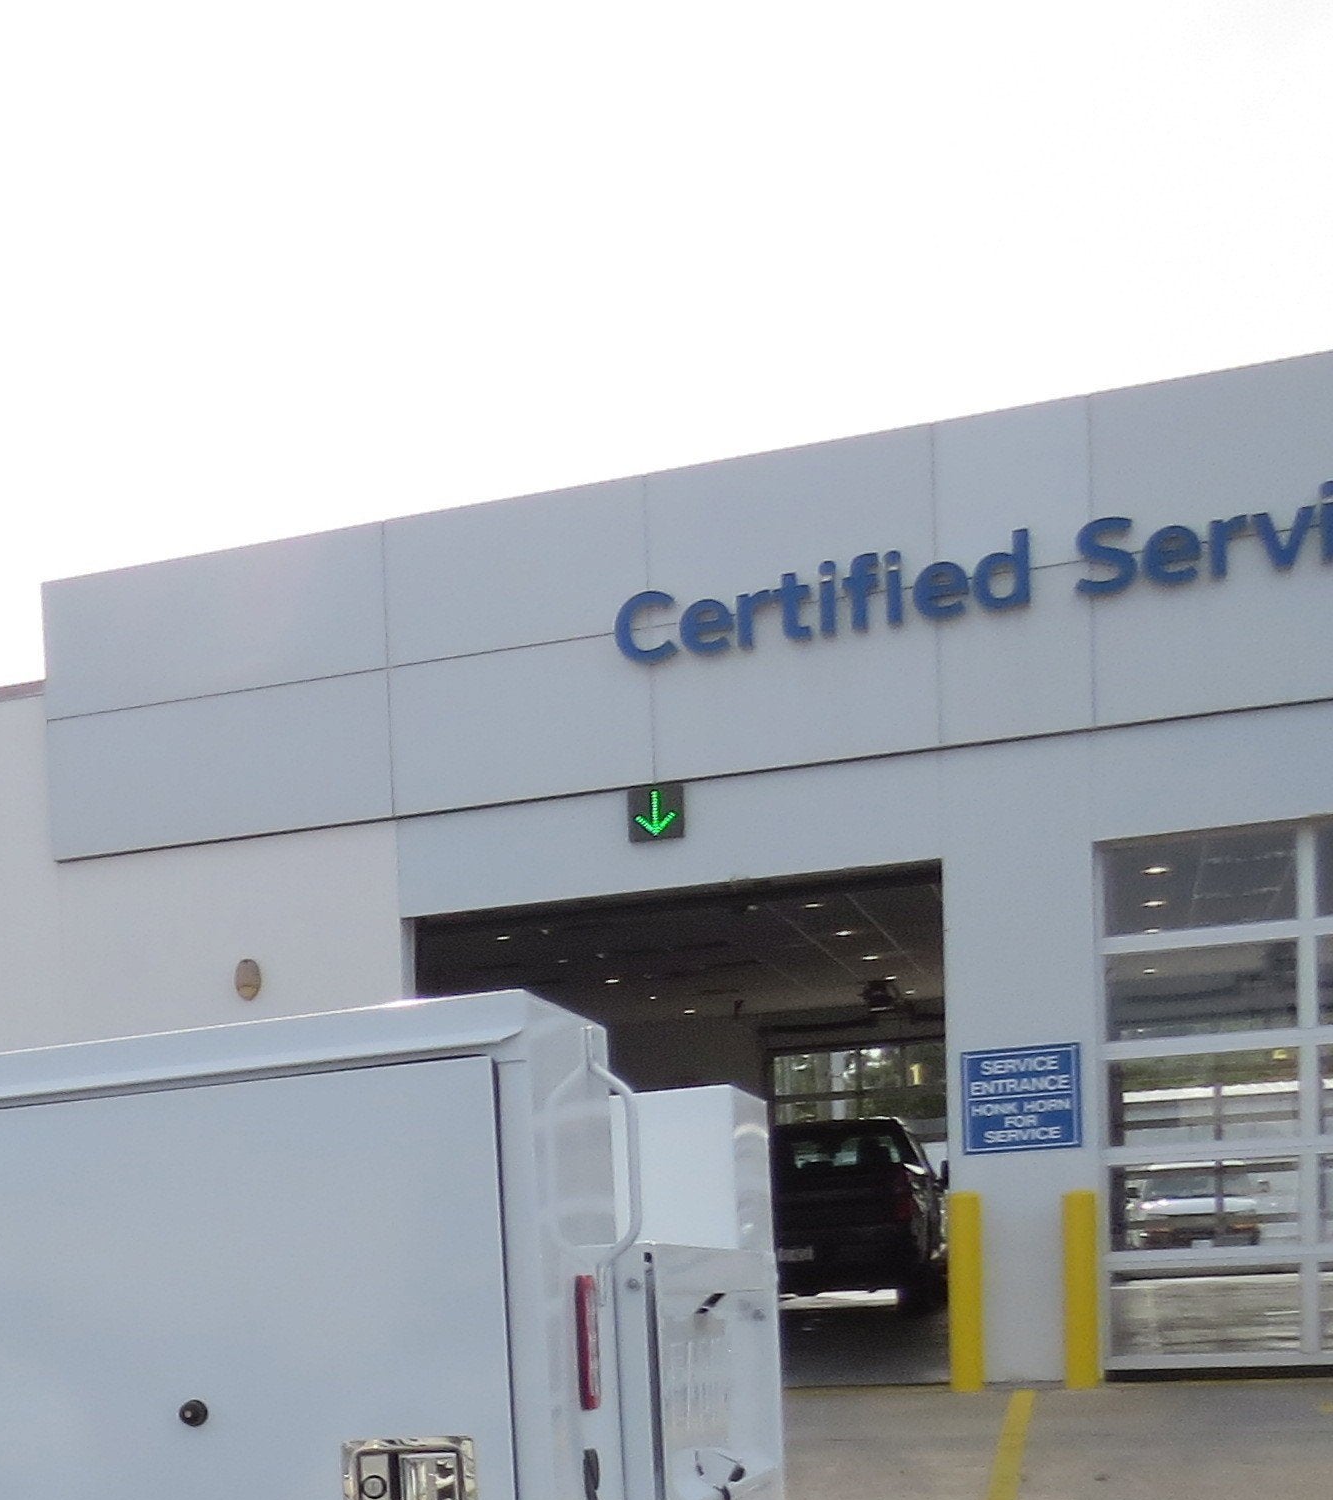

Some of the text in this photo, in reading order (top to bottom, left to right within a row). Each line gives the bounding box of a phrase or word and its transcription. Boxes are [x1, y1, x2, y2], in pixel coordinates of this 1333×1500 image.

[614, 526, 1033, 665] Certified
[909, 1063, 921, 1085] 1
[980, 1055, 1060, 1076] SERVICE
[970, 1074, 1071, 1097] ENTRANCE
[971, 1098, 1071, 1118] HONK HORN
[1004, 1115, 1039, 1128] FOR
[983, 1126, 1061, 1144] SERVICE
